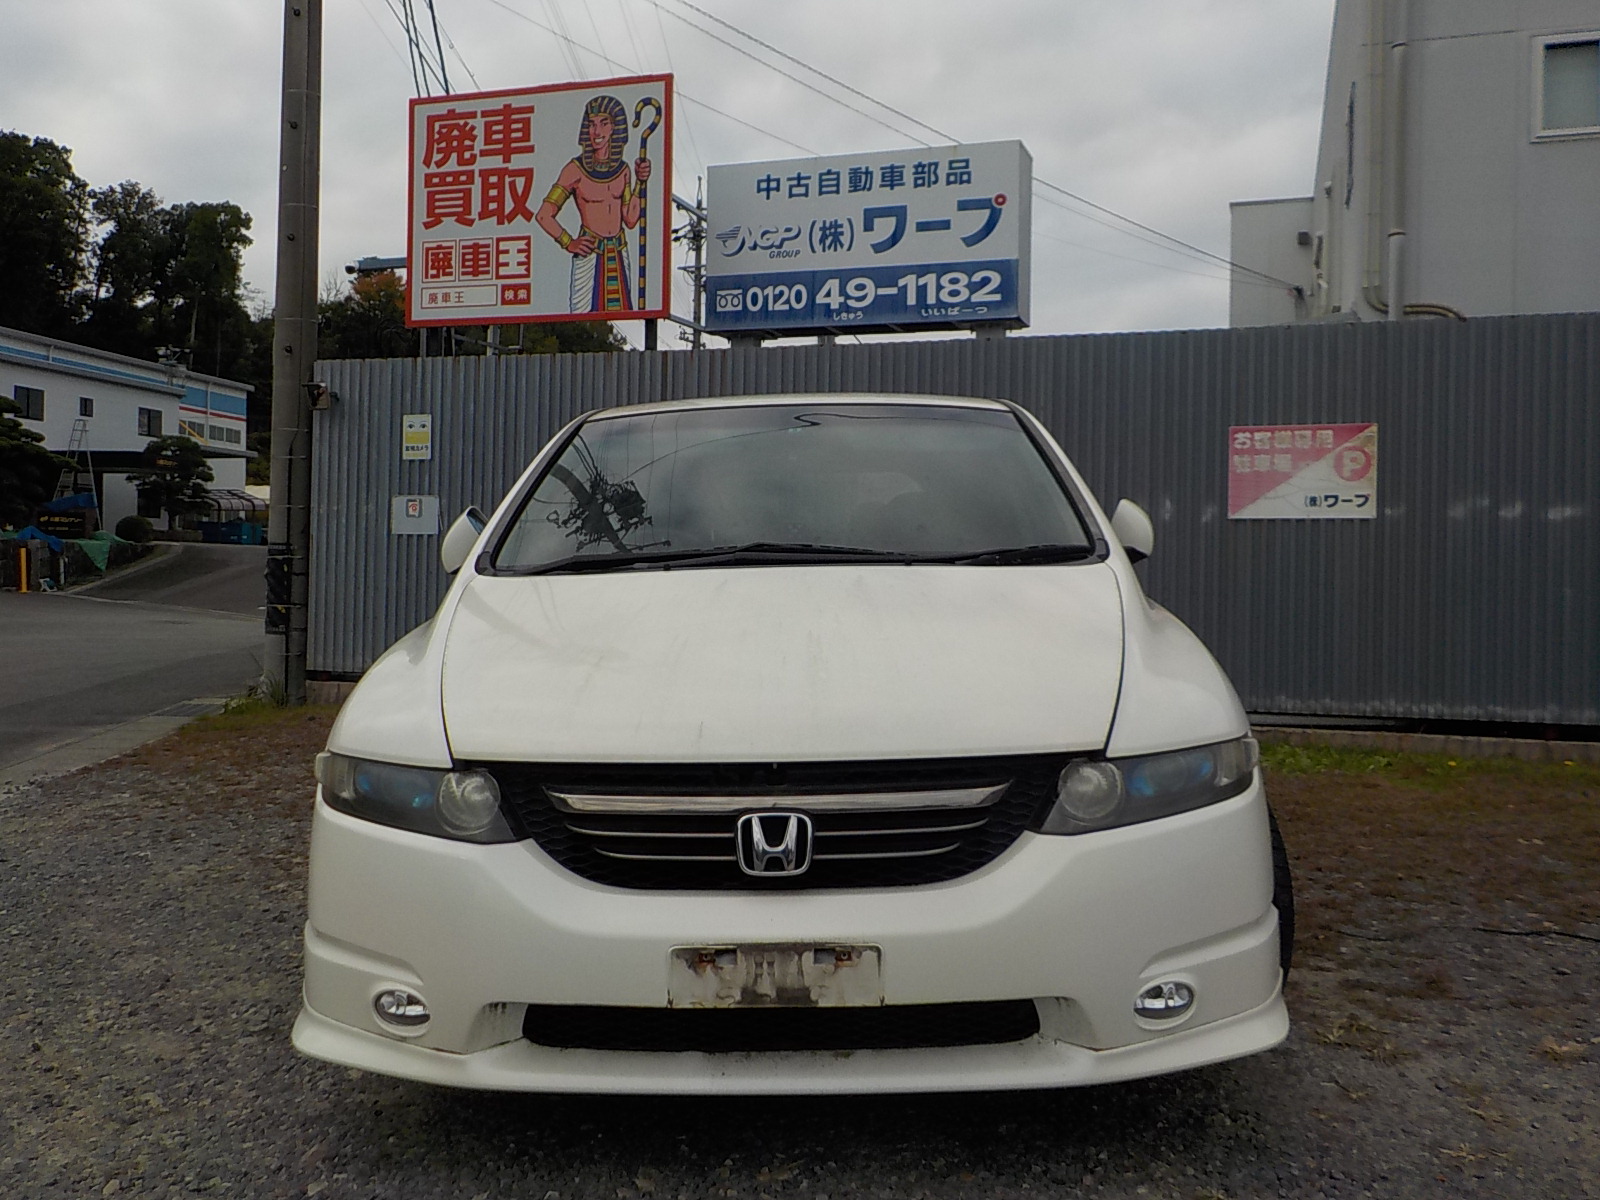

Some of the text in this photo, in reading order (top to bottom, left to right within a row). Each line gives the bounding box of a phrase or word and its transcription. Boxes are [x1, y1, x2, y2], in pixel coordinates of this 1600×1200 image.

[422, 104, 535, 169] 廃車
[422, 167, 534, 230] 買取
[756, 158, 972, 201] 中古自動車部品
[768, 249, 801, 259] GROUP
[427, 291, 464, 305] 廃車王
[504, 289, 528, 300] 検索
[746, 270, 1002, 312] 0120 49-1182
